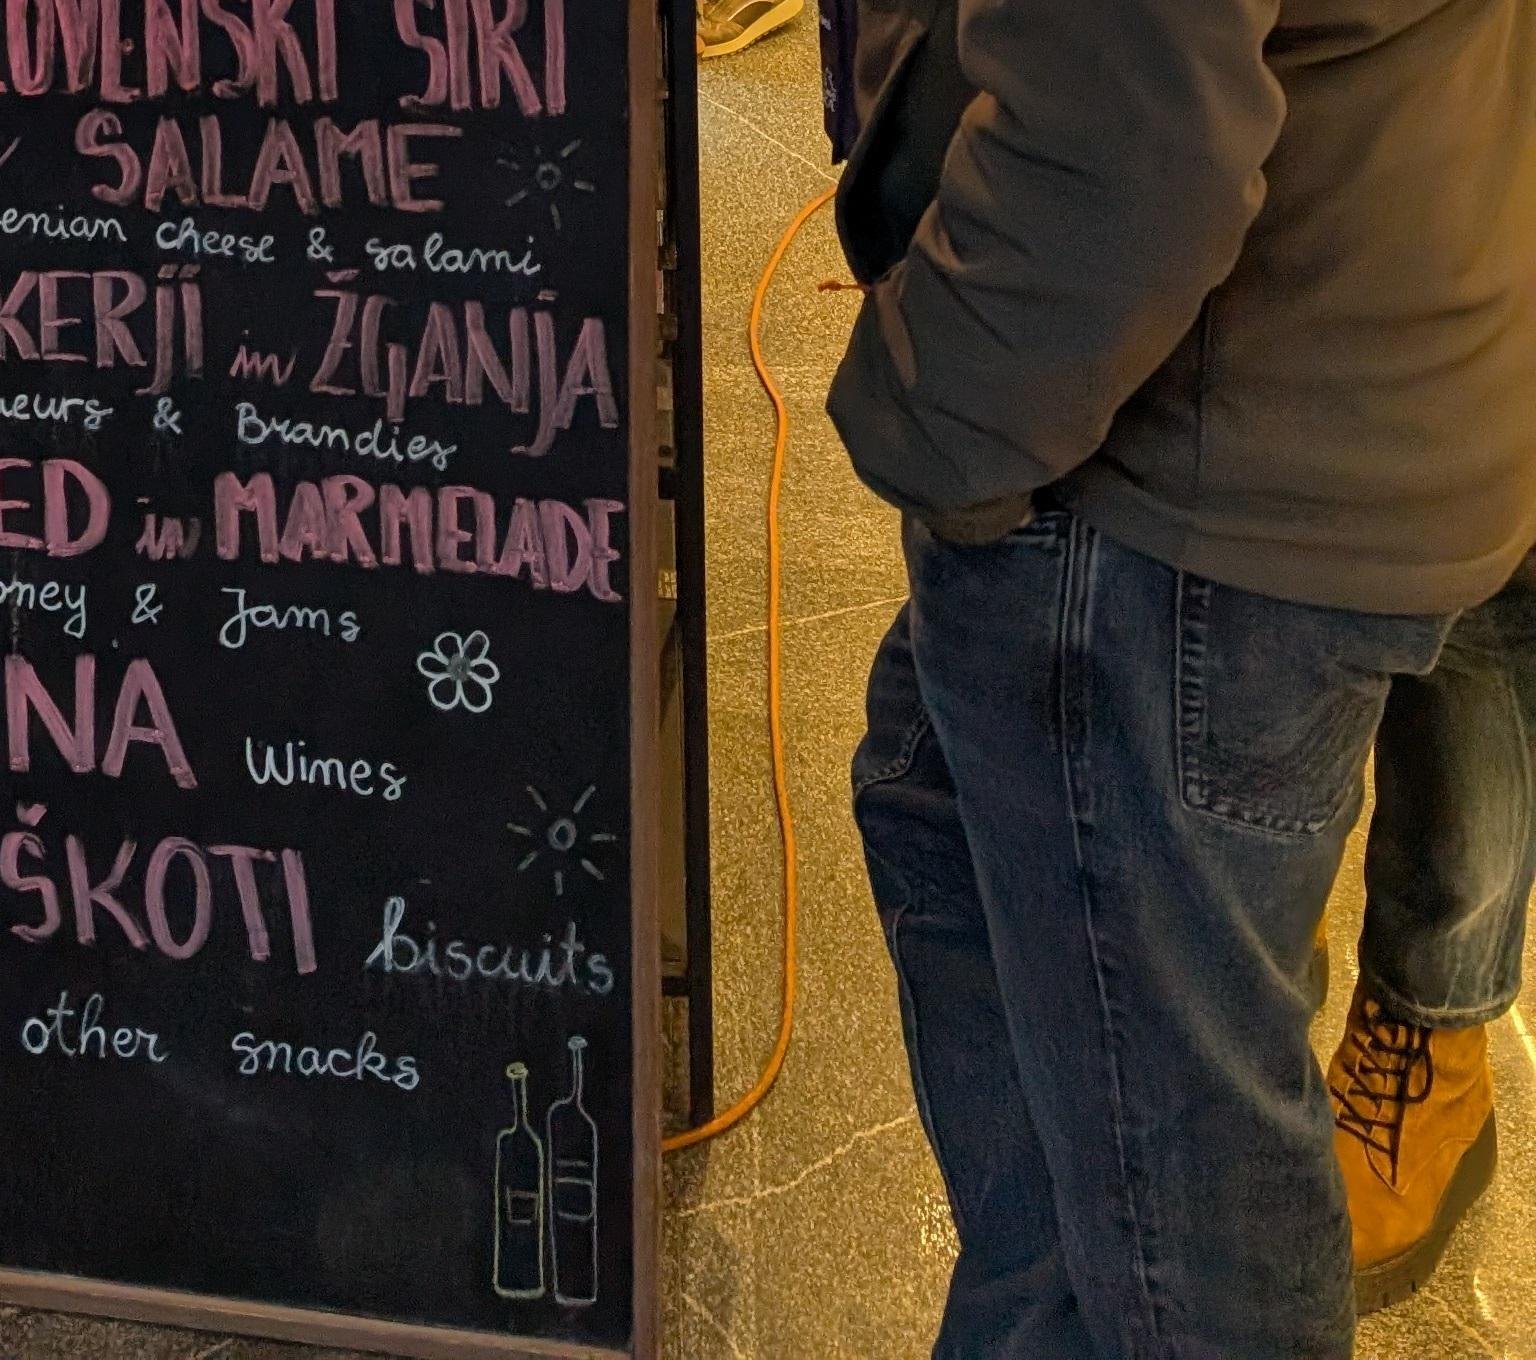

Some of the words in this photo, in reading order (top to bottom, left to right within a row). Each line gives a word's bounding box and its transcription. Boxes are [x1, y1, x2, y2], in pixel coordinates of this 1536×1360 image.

[74, 107, 463, 216] SALAME
[156, 211, 277, 264] cheese
[307, 223, 335, 264] &
[364, 233, 542, 278] salami
[230, 329, 297, 387] in
[309, 268, 620, 458] ŽGANJA
[153, 396, 183, 435] &
[236, 401, 457, 470] Brandies
[135, 496, 201, 563] in
[214, 470, 626, 604] MARMELADE
[131, 582, 164, 626] &
[218, 585, 362, 650] Jams
[364, 894, 616, 995] biscuits
[20, 990, 170, 1065] other
[231, 1029, 422, 1092] snacks
